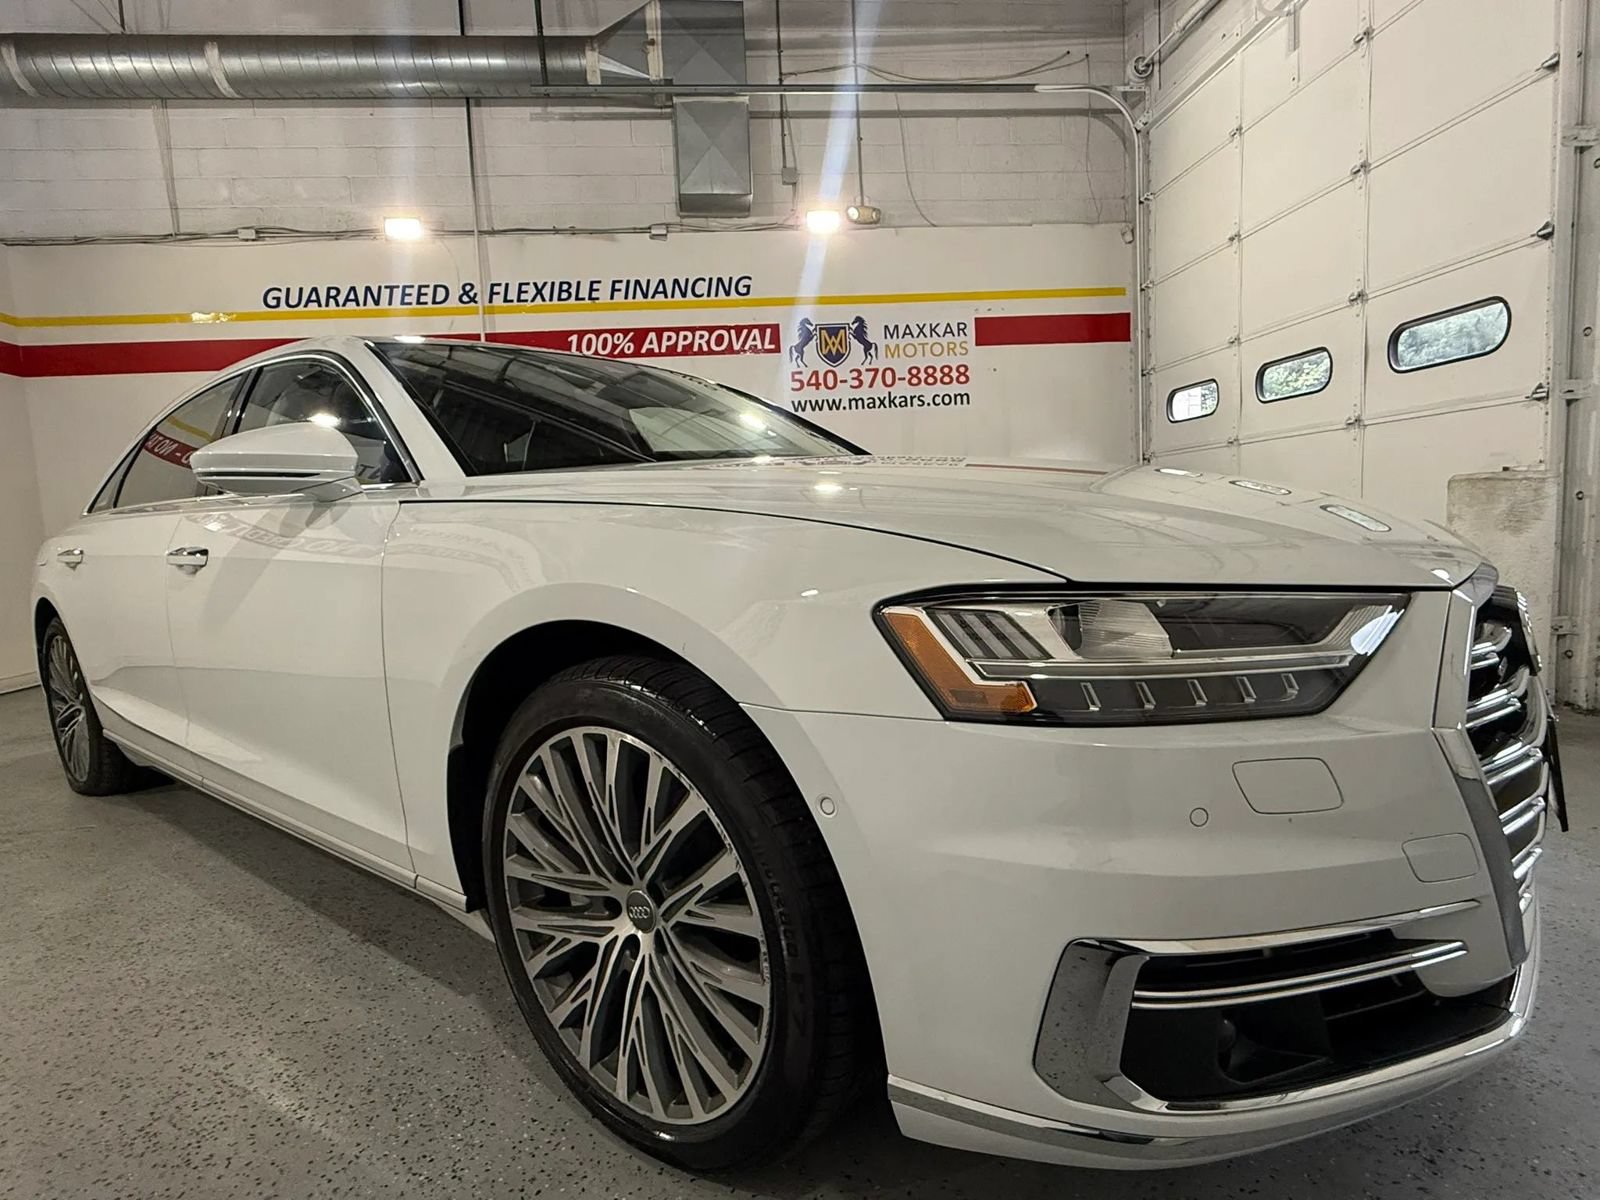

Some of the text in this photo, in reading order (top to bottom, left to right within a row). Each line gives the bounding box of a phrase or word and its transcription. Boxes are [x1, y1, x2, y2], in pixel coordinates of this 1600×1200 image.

[262, 275, 753, 309] GUARANTEED & FLEXIBLE FINANCING
[567, 328, 777, 356] 100% APPROVAL
[883, 322, 968, 340] MAXKAR
[884, 341, 969, 359] MOTORS
[790, 363, 970, 392] 540-370-8888
[791, 391, 971, 413] www.maxkars.com
